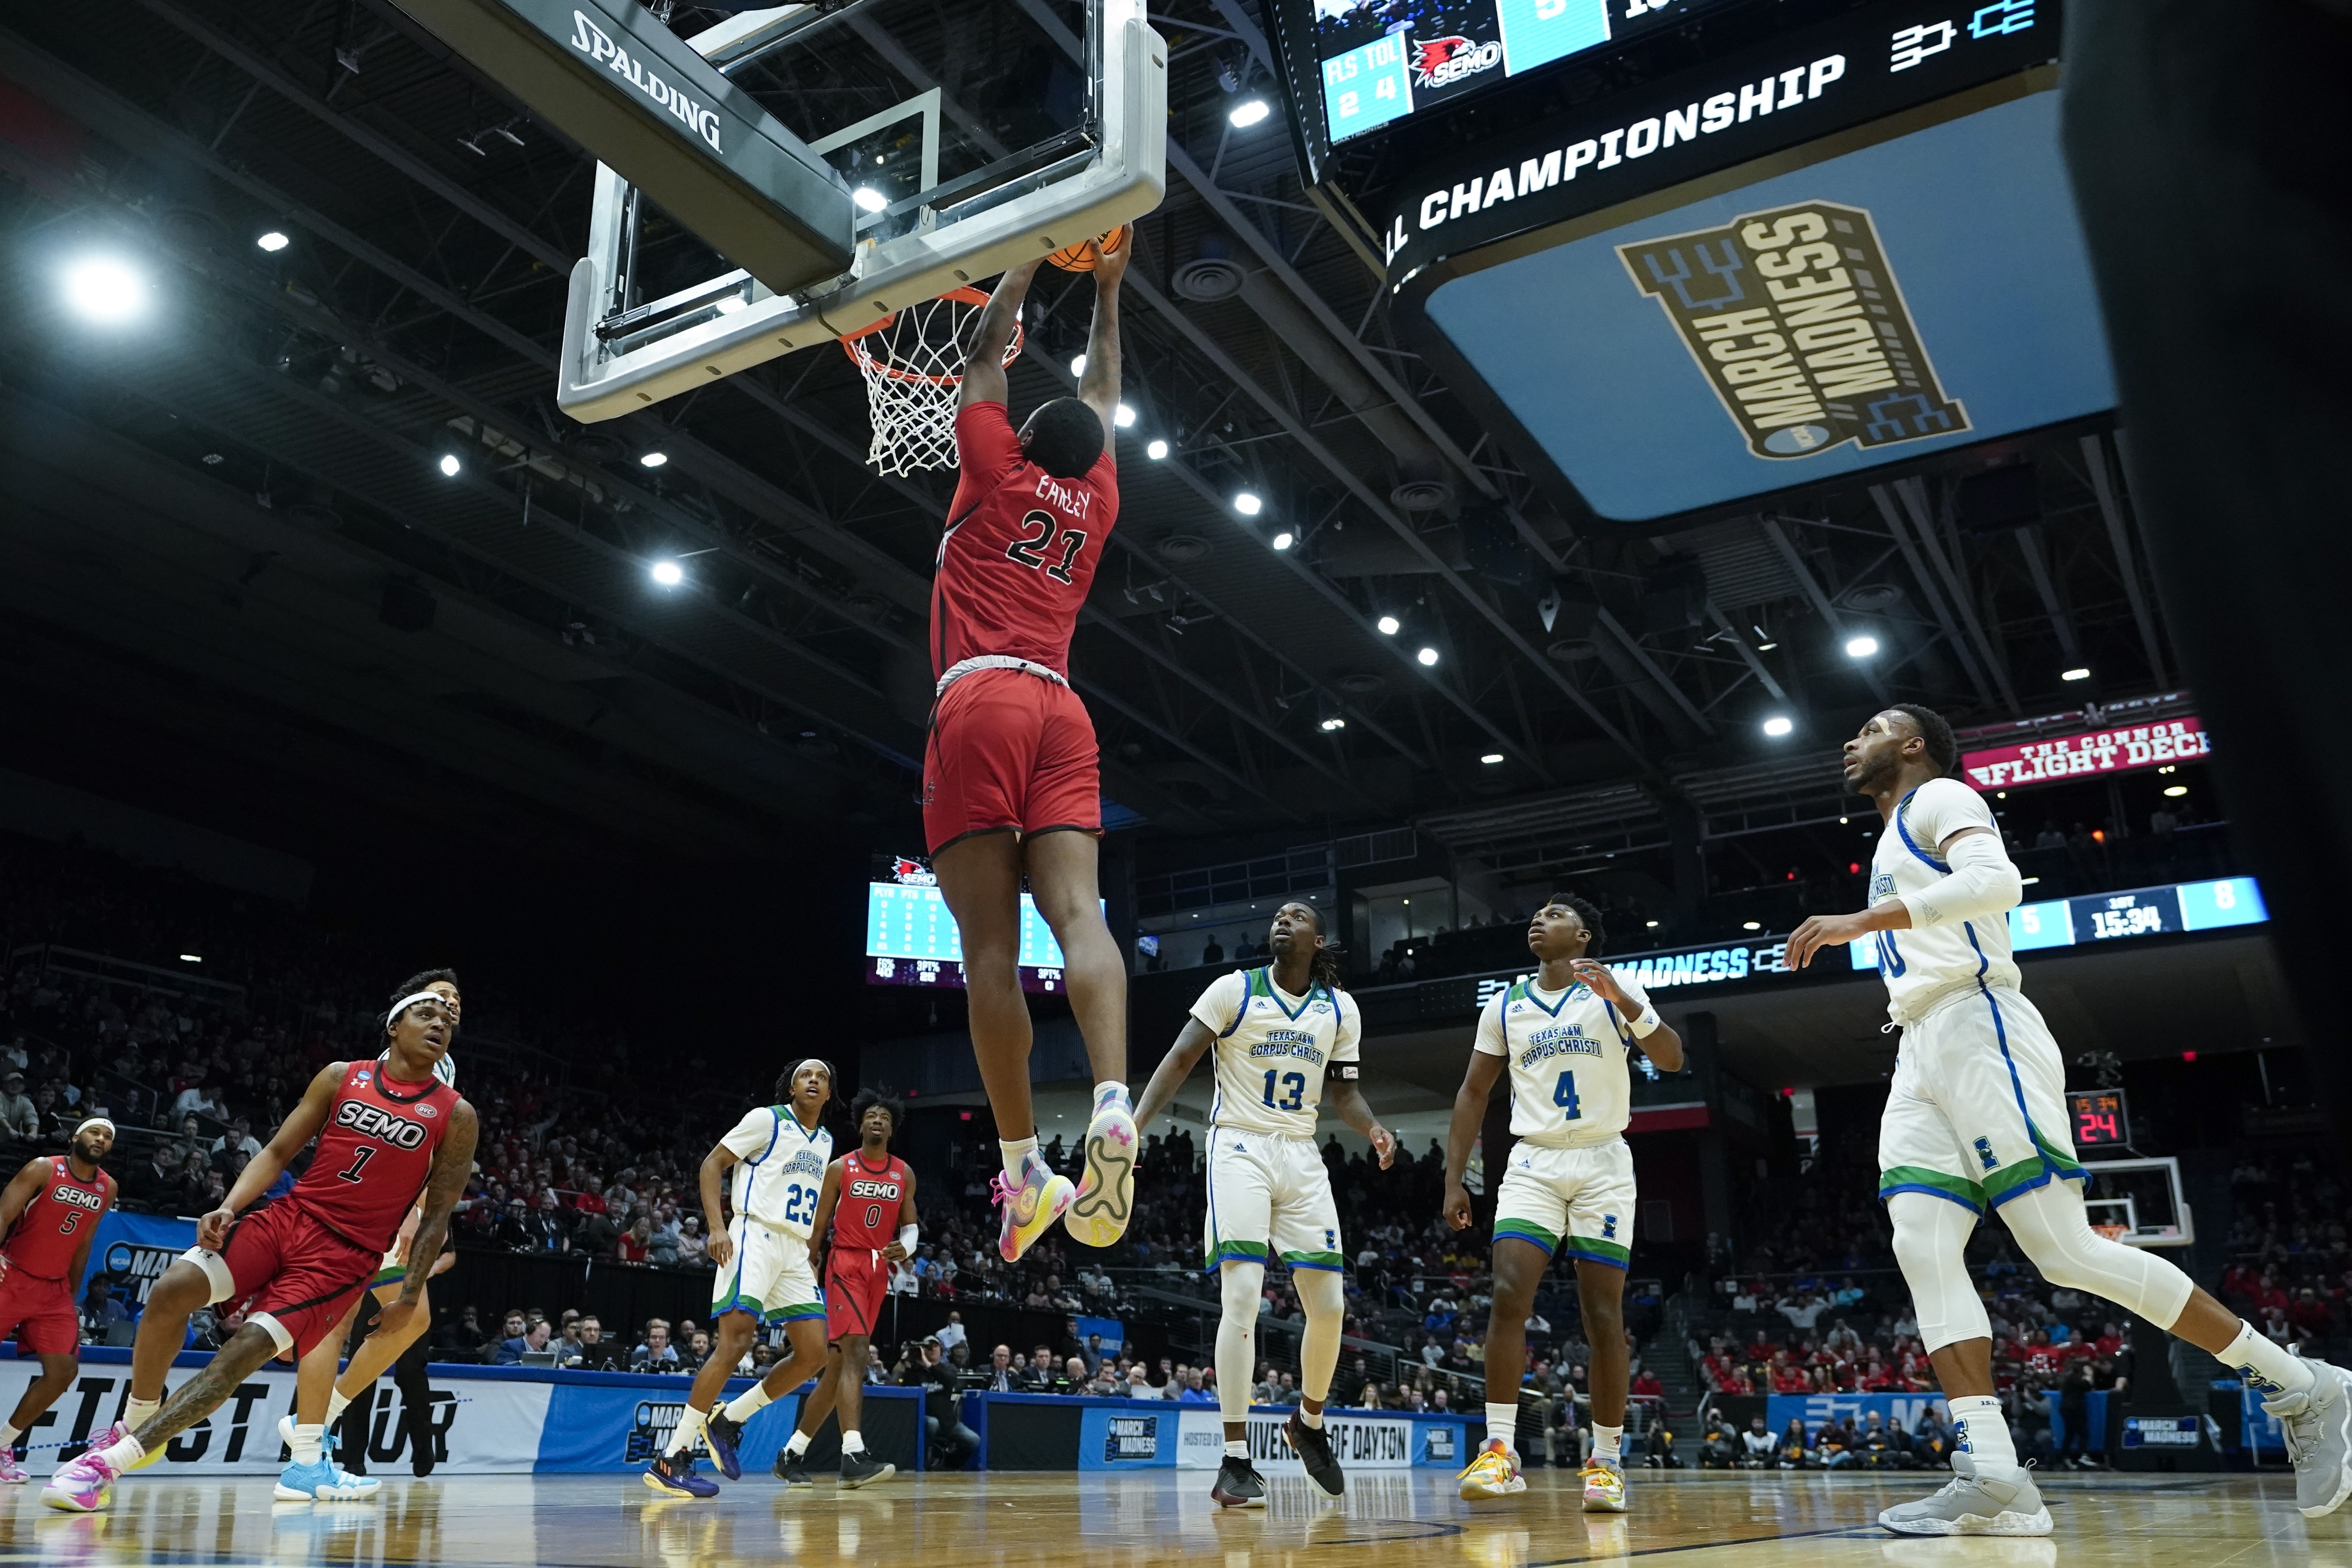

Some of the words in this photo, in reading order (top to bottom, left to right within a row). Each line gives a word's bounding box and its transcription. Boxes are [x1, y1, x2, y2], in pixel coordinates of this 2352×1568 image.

[1326, 54, 1358, 86] FLS
[1364, 40, 1399, 70] TOL
[1433, 44, 1500, 83] SEMO
[571, 10, 721, 152] SPALDING
[1339, 91, 1359, 118] 2
[1375, 75, 1397, 100] 4
[1420, 54, 1846, 230] CHAMPIONSHIP
[1741, 212, 1898, 399] MADNESS
[1692, 307, 1826, 429] MARCH
[1035, 475, 1090, 520] EARLEY
[1005, 509, 1087, 585] 21
[2020, 741, 2070, 760] THE
[2081, 722, 2186, 749] CONNOR
[1989, 745, 2118, 786] FLIGHT
[902, 873, 936, 885] SEMO
[900, 889, 918, 900] PTS
[2109, 896, 2135, 909] 1ST
[2214, 880, 2236, 909] 8
[2021, 907, 2041, 934] 5
[2091, 906, 2162, 938] 15:34
[876, 968, 893, 978] 40
[920, 972, 936, 982] 25
[877, 958, 895, 970] FG%
[917, 960, 941, 973] 3PT%
[1038, 969, 1061, 980] 3PT%
[1045, 981, 1054, 990] 0
[1268, 1032, 1295, 1042] TEXAS
[1297, 1033, 1314, 1047] A&M
[1530, 1028, 1559, 1045] TEXAS
[1561, 1025, 1582, 1038] A&M
[1251, 1043, 1289, 1056] CORPUS
[1291, 1044, 1323, 1066] CHRISTI
[1522, 1042, 1555, 1068] CORPUS
[1558, 1039, 1600, 1057] CHRISTI
[1262, 1069, 1305, 1110] 13
[1553, 1070, 1582, 1121] 4
[338, 1102, 424, 1147] SEMO
[2079, 1114, 2117, 1142] 24
[337, 1146, 377, 1184] 1
[796, 1151, 811, 1161] TEXAS
[812, 1153, 823, 1166] A&M
[808, 1163, 823, 1181] CHRIS
[54, 1186, 102, 1211] SEMO
[851, 1182, 899, 1200] SEMO
[785, 1184, 819, 1226] 23
[865, 1204, 881, 1228] 0
[59, 1211, 82, 1234] 5
[650, 1406, 683, 1428] MAR
[1117, 1420, 1144, 1436] MARCH
[1120, 1437, 1155, 1452] MADNESS
[1184, 1432, 1211, 1446] HOSTED
[1214, 1433, 1223, 1446] BY
[1353, 1425, 1406, 1461] DAYTON
